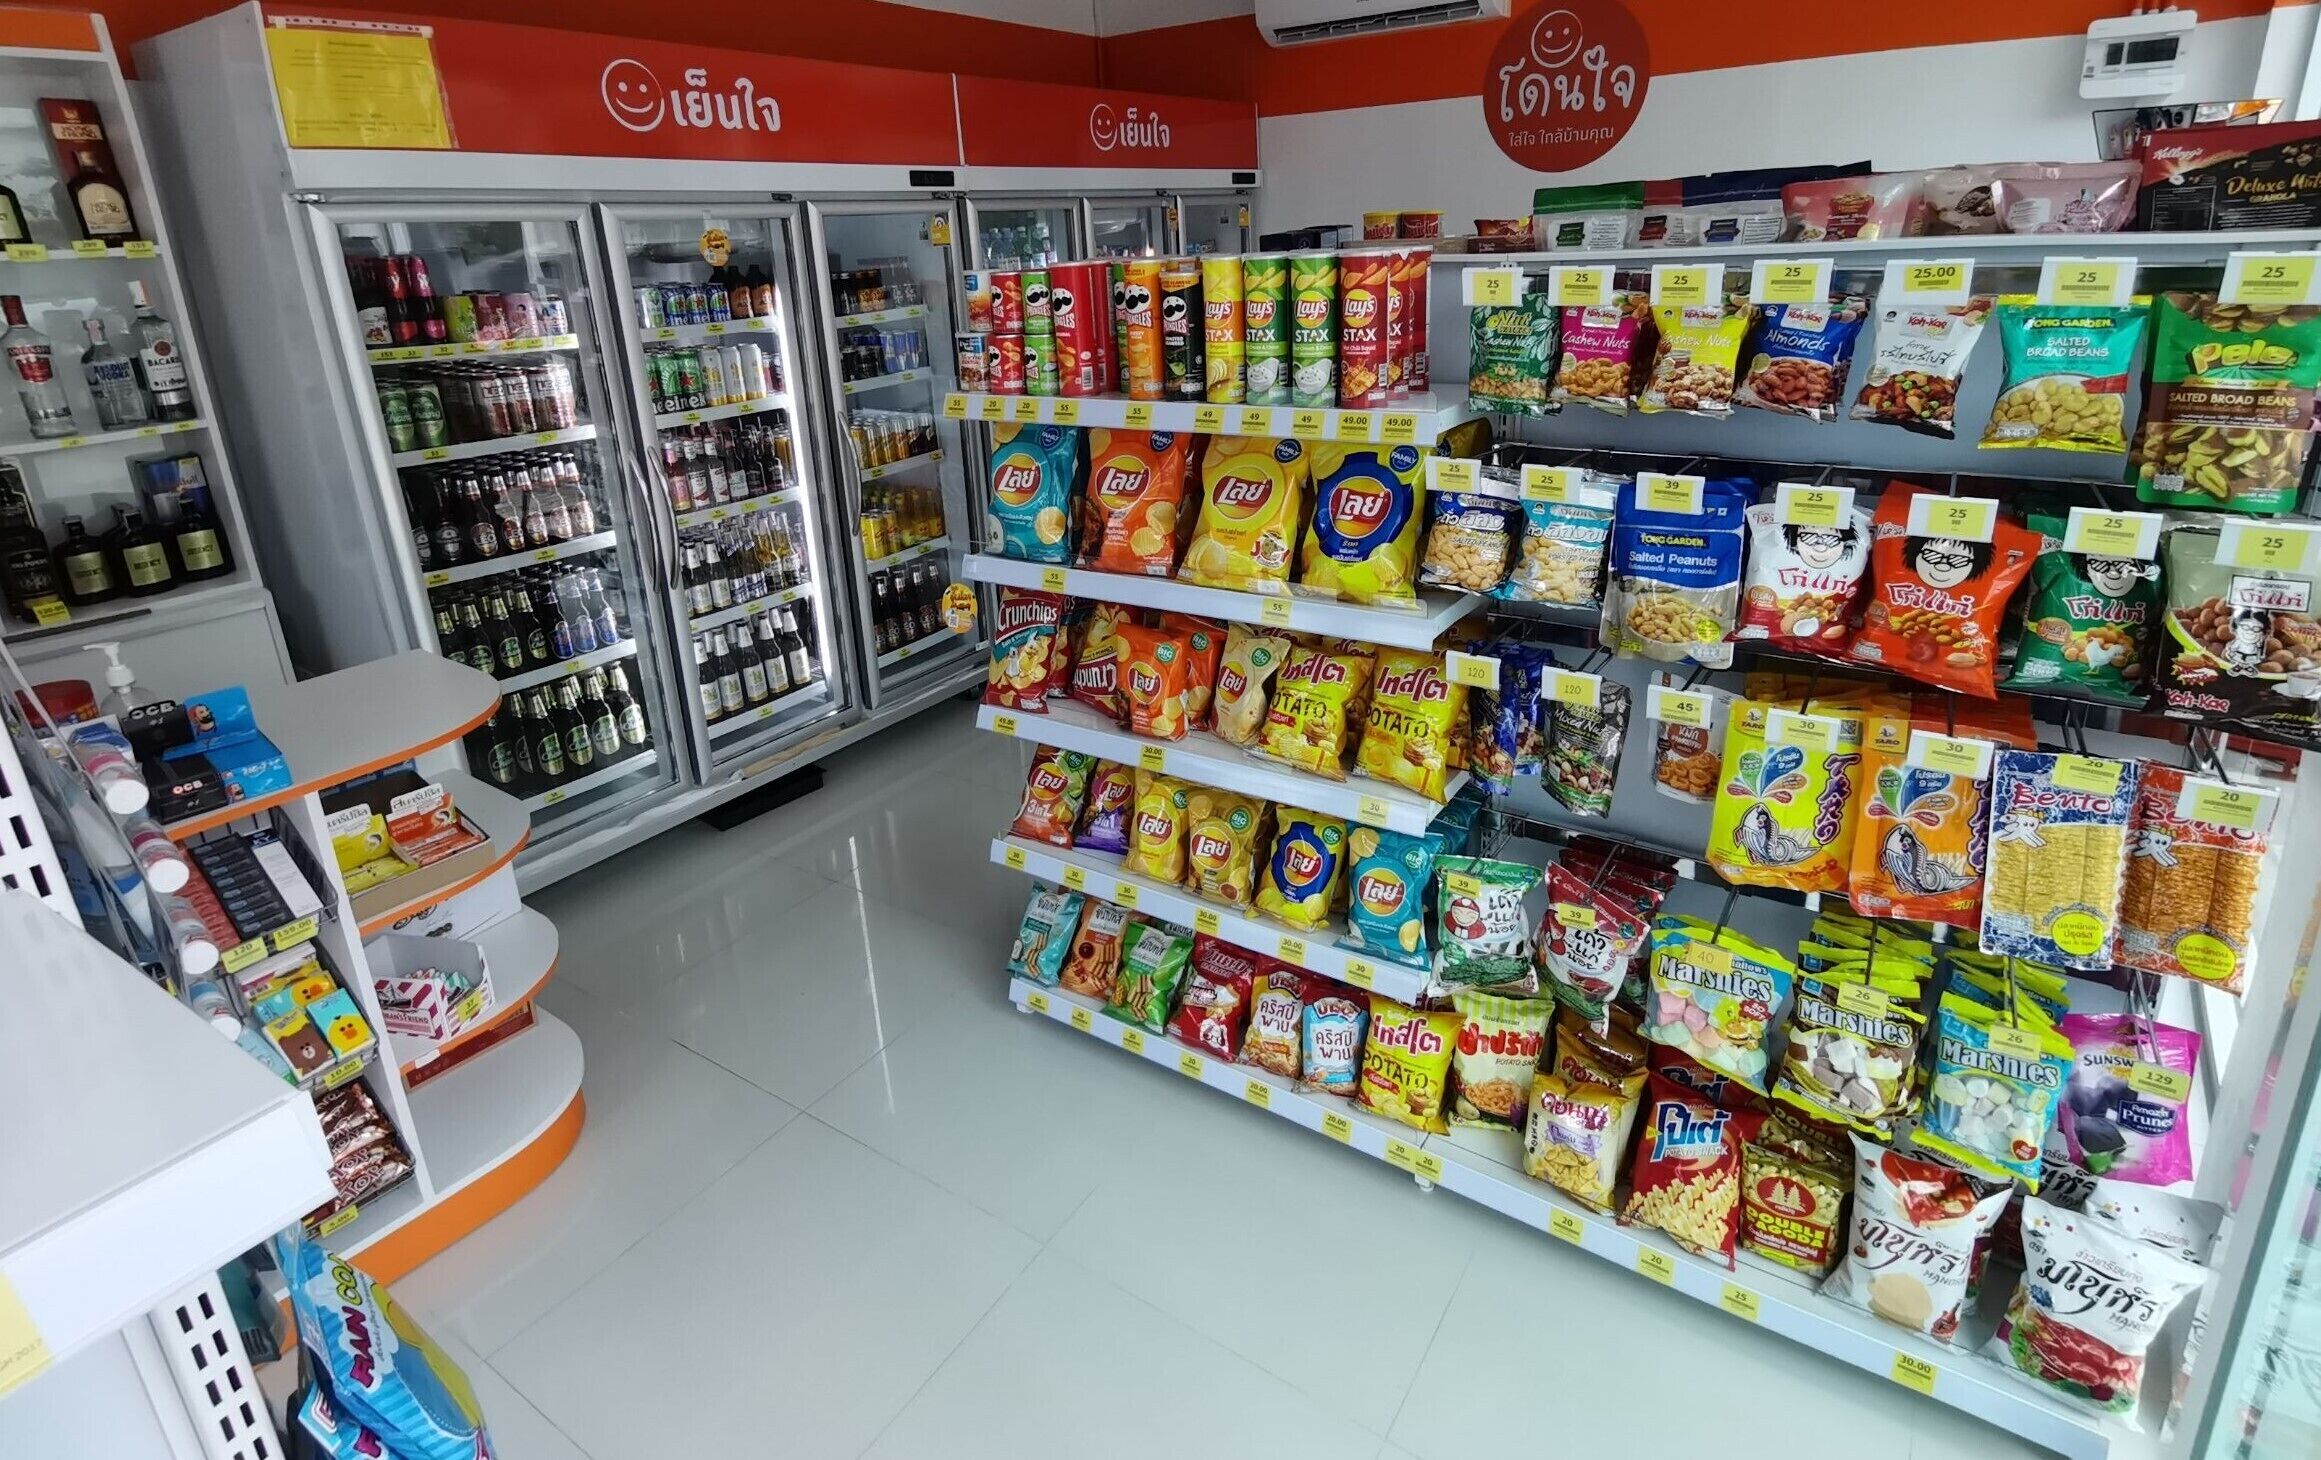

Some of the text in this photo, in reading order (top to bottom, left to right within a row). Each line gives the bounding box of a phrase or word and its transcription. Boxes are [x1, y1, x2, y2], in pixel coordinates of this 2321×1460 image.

[1499, 45, 1636, 122] โดนใจ
[670, 68, 782, 133] เย็นใจ
[1119, 107, 1171, 149] เย็นใจ
[2226, 175, 2287, 197] Deluxe
[1574, 273, 1589, 283] 25
[1784, 267, 1801, 277] 25
[1913, 266, 1956, 279] 25.00
[2077, 271, 2097, 283] 25
[2260, 266, 2286, 278] 25
[1486, 279, 1500, 289] 25
[1673, 275, 1689, 285] 25
[1296, 300, 1327, 321] Lay's
[1344, 299, 1375, 320] Lay's
[1295, 328, 1330, 342] STAX
[1343, 328, 1377, 342] STAX
[1561, 331, 1630, 349] Cashew Nuts
[1765, 330, 1831, 352] Almonds
[2046, 336, 2091, 347] SALTED
[2026, 346, 2109, 358] BROAD BEANS
[2168, 392, 2297, 408] SALTED BROAD BEANS
[1202, 410, 1213, 419] 49
[1250, 412, 1260, 421] 49
[1301, 415, 1312, 424] 49
[1342, 416, 1368, 426] 49.00
[1386, 418, 1413, 428] 49.00
[1040, 430, 1061, 442] FAMILY
[1151, 432, 1174, 444] FAMILY
[1275, 442, 1301, 455] FAMILY
[1390, 451, 1418, 466] FAMILY
[1448, 464, 1461, 473] 25
[1540, 475, 1554, 485] 25
[1664, 480, 1680, 490] 39
[1807, 492, 1824, 502] 25
[1949, 508, 1967, 519] 25
[2103, 517, 2124, 529] 25
[2263, 536, 2284, 549] 25
[1628, 550, 1718, 567] Salted Peanuts
[1272, 603, 1283, 611] 55
[998, 600, 1058, 632] Crunchips
[1252, 651, 1269, 664] BIG
[1467, 667, 1485, 679] 120
[1563, 684, 1582, 697] 120
[2164, 687, 2231, 714] Koh-Kae
[129, 702, 176, 720] OCB
[1676, 702, 1694, 713] 45
[1799, 721, 1816, 730] 30
[1944, 743, 1964, 753] 30
[171, 780, 203, 795] OCB
[2011, 783, 2112, 816] Bento
[2220, 792, 2240, 802] 20
[1231, 813, 1247, 825] BIG
[1324, 830, 1340, 842] BIG
[1457, 879, 1470, 889] 39
[1568, 910, 1583, 920] 39
[1697, 952, 1715, 964] 40
[1355, 964, 1366, 973] 30
[1855, 989, 1870, 1000] 26
[2007, 1033, 2023, 1043] 26
[2083, 1054, 2135, 1068] SUNSW
[2146, 1072, 2174, 1086] 129
[1327, 1113, 1347, 1128] 20.00
[1395, 1145, 1405, 1154] 20
[1422, 1156, 1434, 1166] 20
[1562, 1215, 1574, 1228] 20
[1744, 1204, 1826, 1240] DOUBLE
[1650, 1253, 1663, 1266] 20
[1900, 1354, 1932, 1375] 30.00
